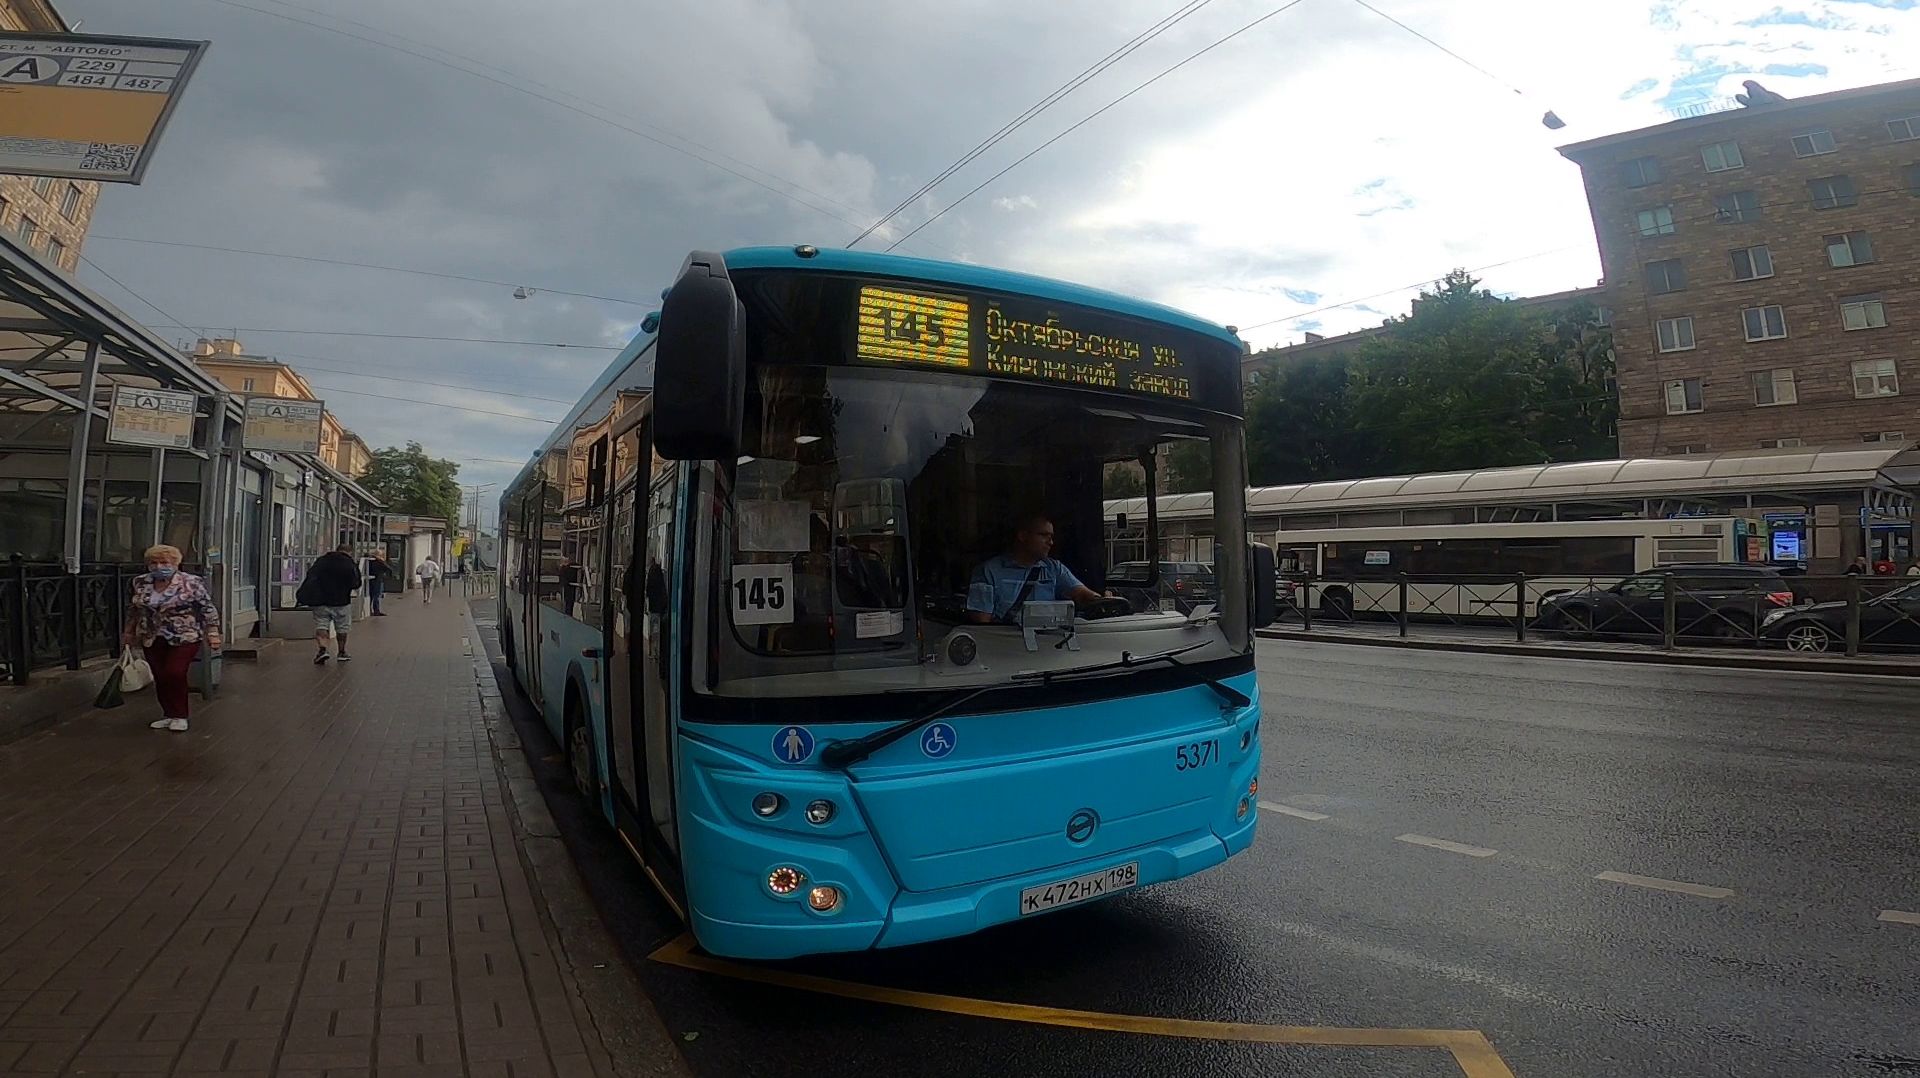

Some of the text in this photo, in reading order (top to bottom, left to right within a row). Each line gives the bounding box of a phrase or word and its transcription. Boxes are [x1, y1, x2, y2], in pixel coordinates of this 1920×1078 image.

[46, 46, 131, 56] "АВТОВО"
[1, 57, 40, 80] А
[76, 60, 116, 71] 229
[67, 75, 164, 90] 484 487
[878, 308, 946, 348] 145
[734, 578, 785, 611] 145
[1175, 739, 1219, 771] 5371
[1108, 865, 1134, 883] 198
